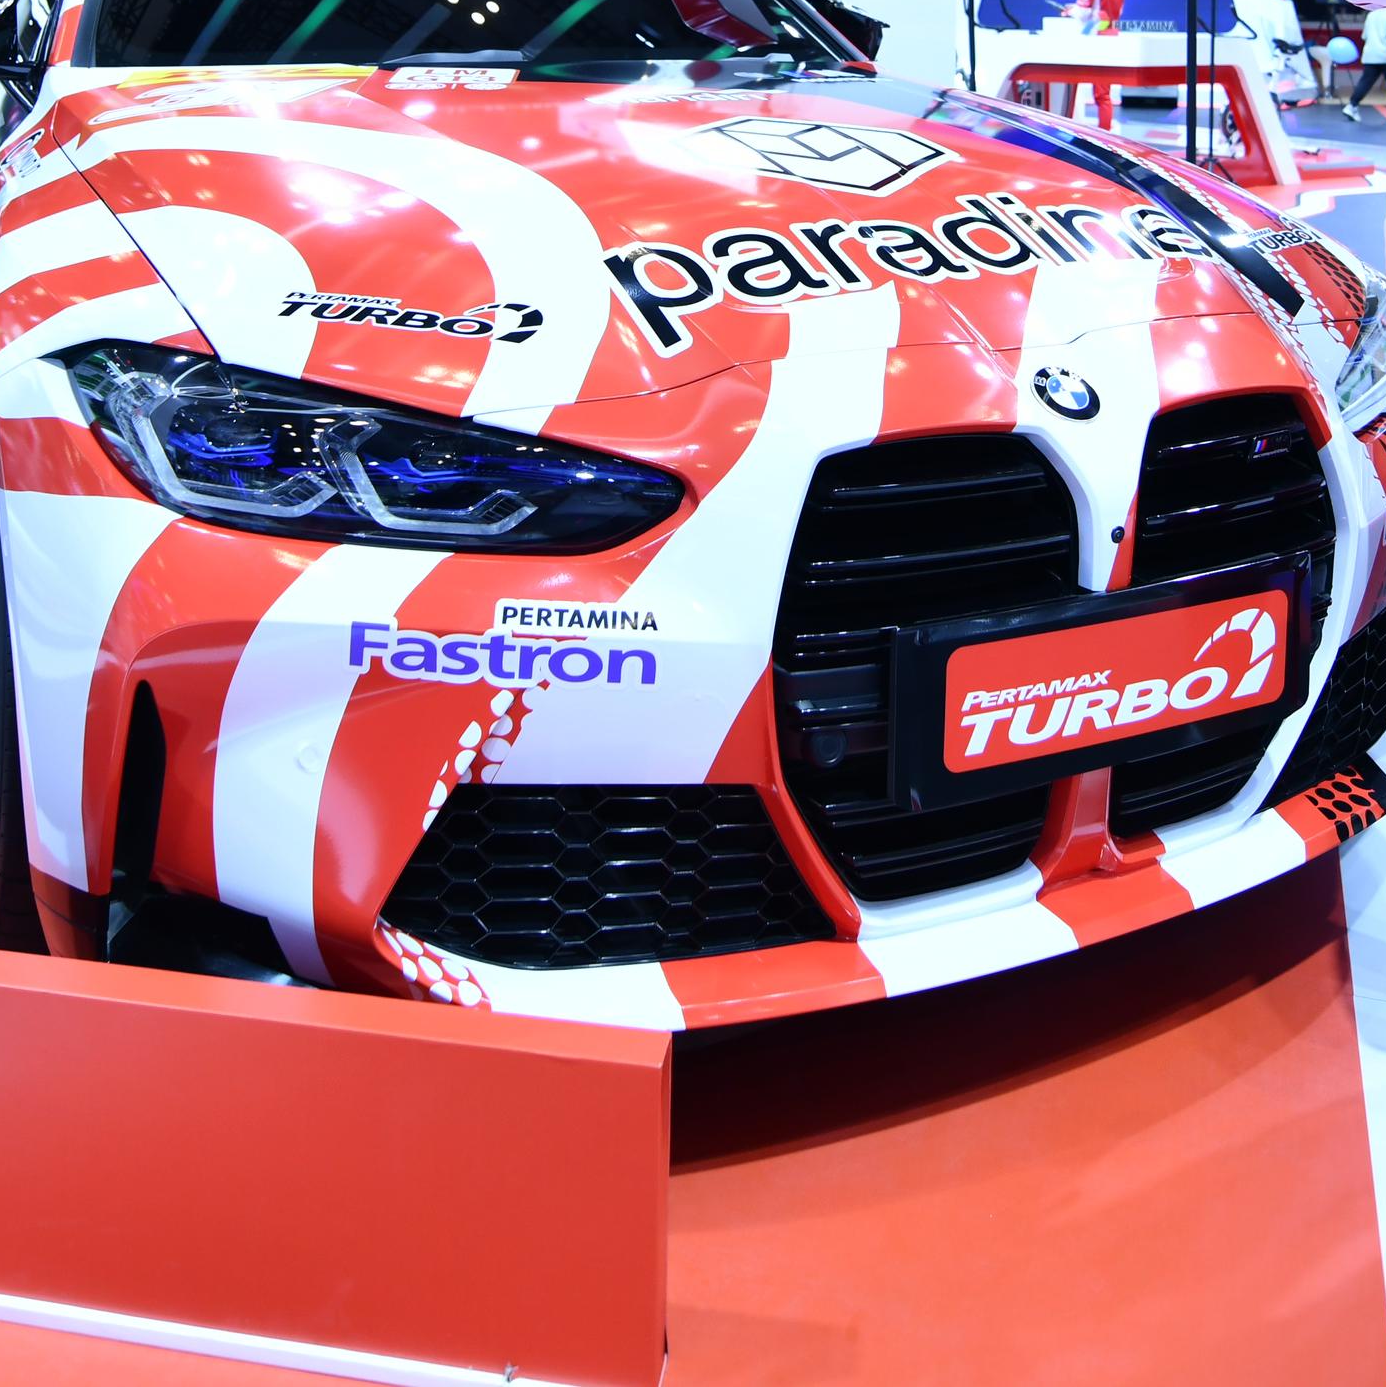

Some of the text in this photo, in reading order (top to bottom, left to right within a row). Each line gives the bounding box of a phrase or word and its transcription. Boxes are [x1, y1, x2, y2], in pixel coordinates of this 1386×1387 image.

[1247, 229, 1313, 253] TURBO
[604, 196, 1213, 349] paradine
[277, 301, 494, 336] TURBO
[286, 291, 398, 307] PERTAMAX
[501, 605, 658, 632] PERTAMINA
[347, 620, 658, 686] Fastron
[960, 669, 1112, 712] PERTAMAX
[960, 666, 1229, 757] TURBO
